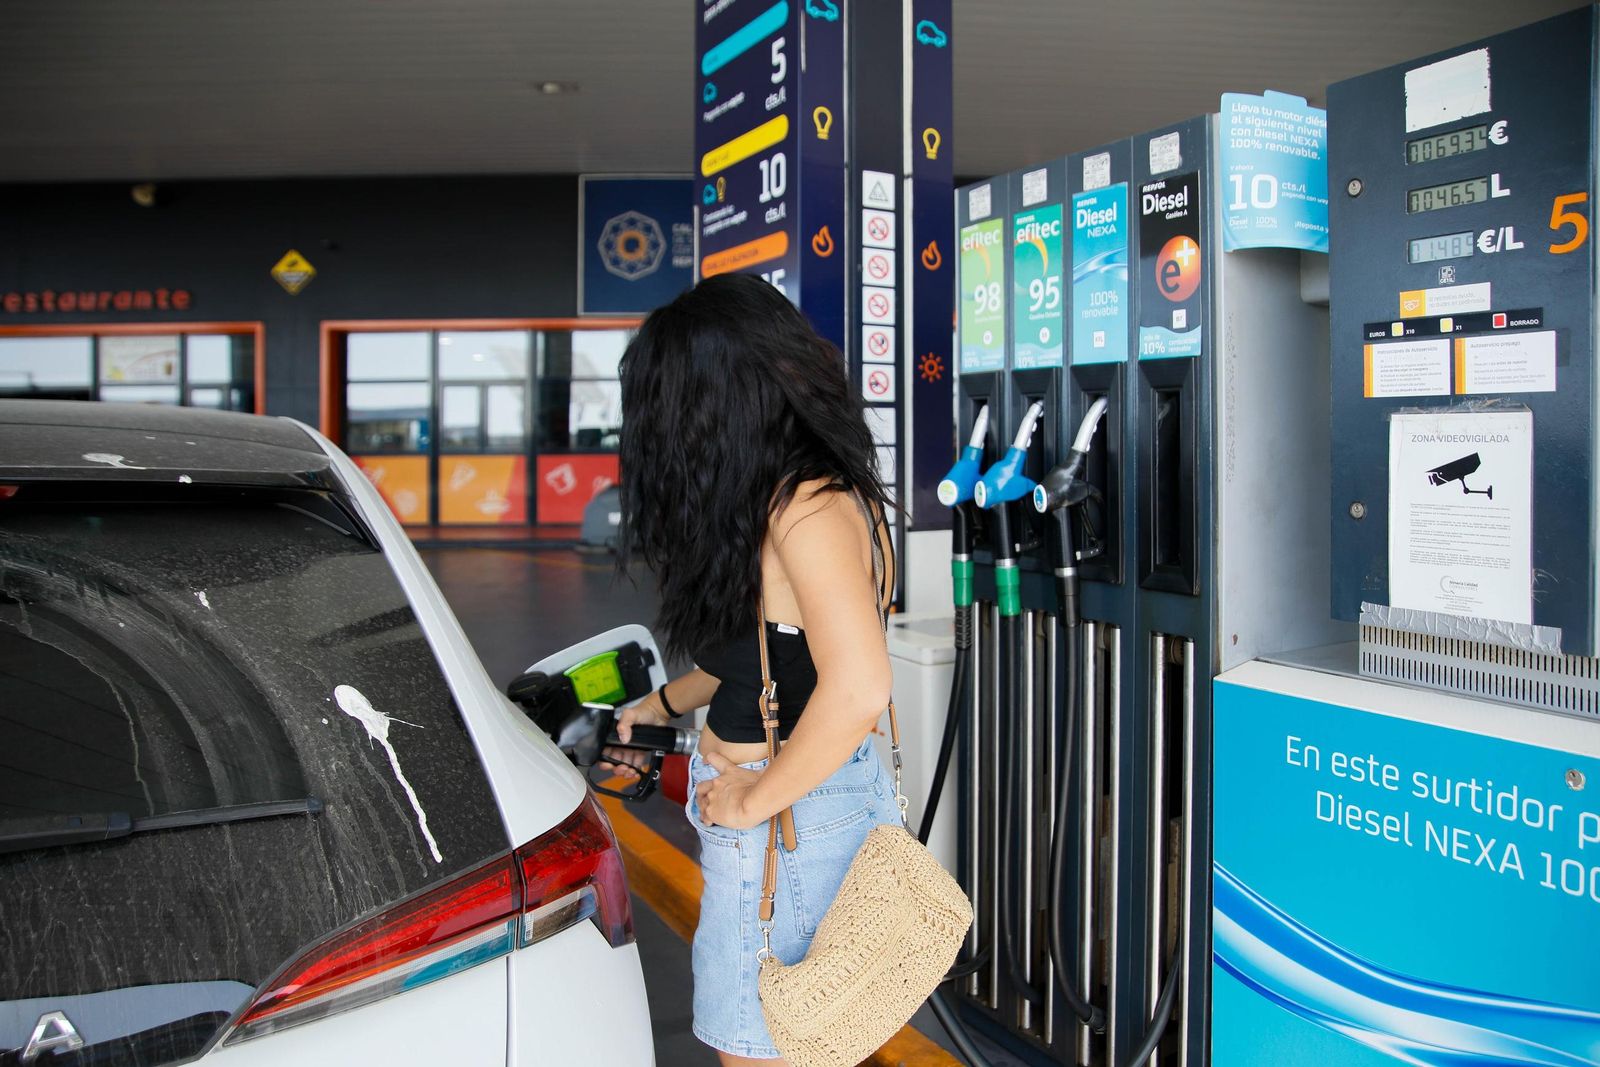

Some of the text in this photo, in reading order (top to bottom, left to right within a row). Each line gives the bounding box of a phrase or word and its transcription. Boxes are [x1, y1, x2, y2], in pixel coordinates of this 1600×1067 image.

[771, 37, 787, 84] 5
[1231, 115, 1322, 138] al siguiente nivel
[1232, 102, 1327, 128] Lleva tu motor diés
[1231, 128, 1319, 148] con Diesel NEXA
[1488, 120, 1509, 145] €
[1230, 139, 1321, 160] 100% renovable.
[759, 152, 787, 203] 10
[1491, 173, 1511, 198] L
[1143, 185, 1188, 215] Diesel
[1229, 174, 1278, 211] 10
[1410, 180, 1487, 212] 0046.5
[1076, 201, 1117, 230] Diesel
[1549, 192, 1589, 254] 5
[963, 229, 1000, 252] efitec
[1016, 220, 1060, 244] efitec
[1087, 223, 1117, 238] NEXA
[1477, 226, 1525, 253] €/L
[0, 287, 193, 313] estaurante
[974, 281, 1001, 315] 98
[1028, 275, 1060, 312] 95
[1090, 290, 1119, 306] 100%
[1081, 305, 1119, 319] renovable
[1143, 340, 1166, 355] 10%
[1411, 434, 1510, 443] ZONA VIDEOVIGILADA
[1286, 735, 1320, 771] En
[1331, 751, 1400, 792] este
[1412, 771, 1563, 833] surtidor
[1315, 790, 1413, 848] Diesel
[1425, 820, 1525, 881] NEXA
